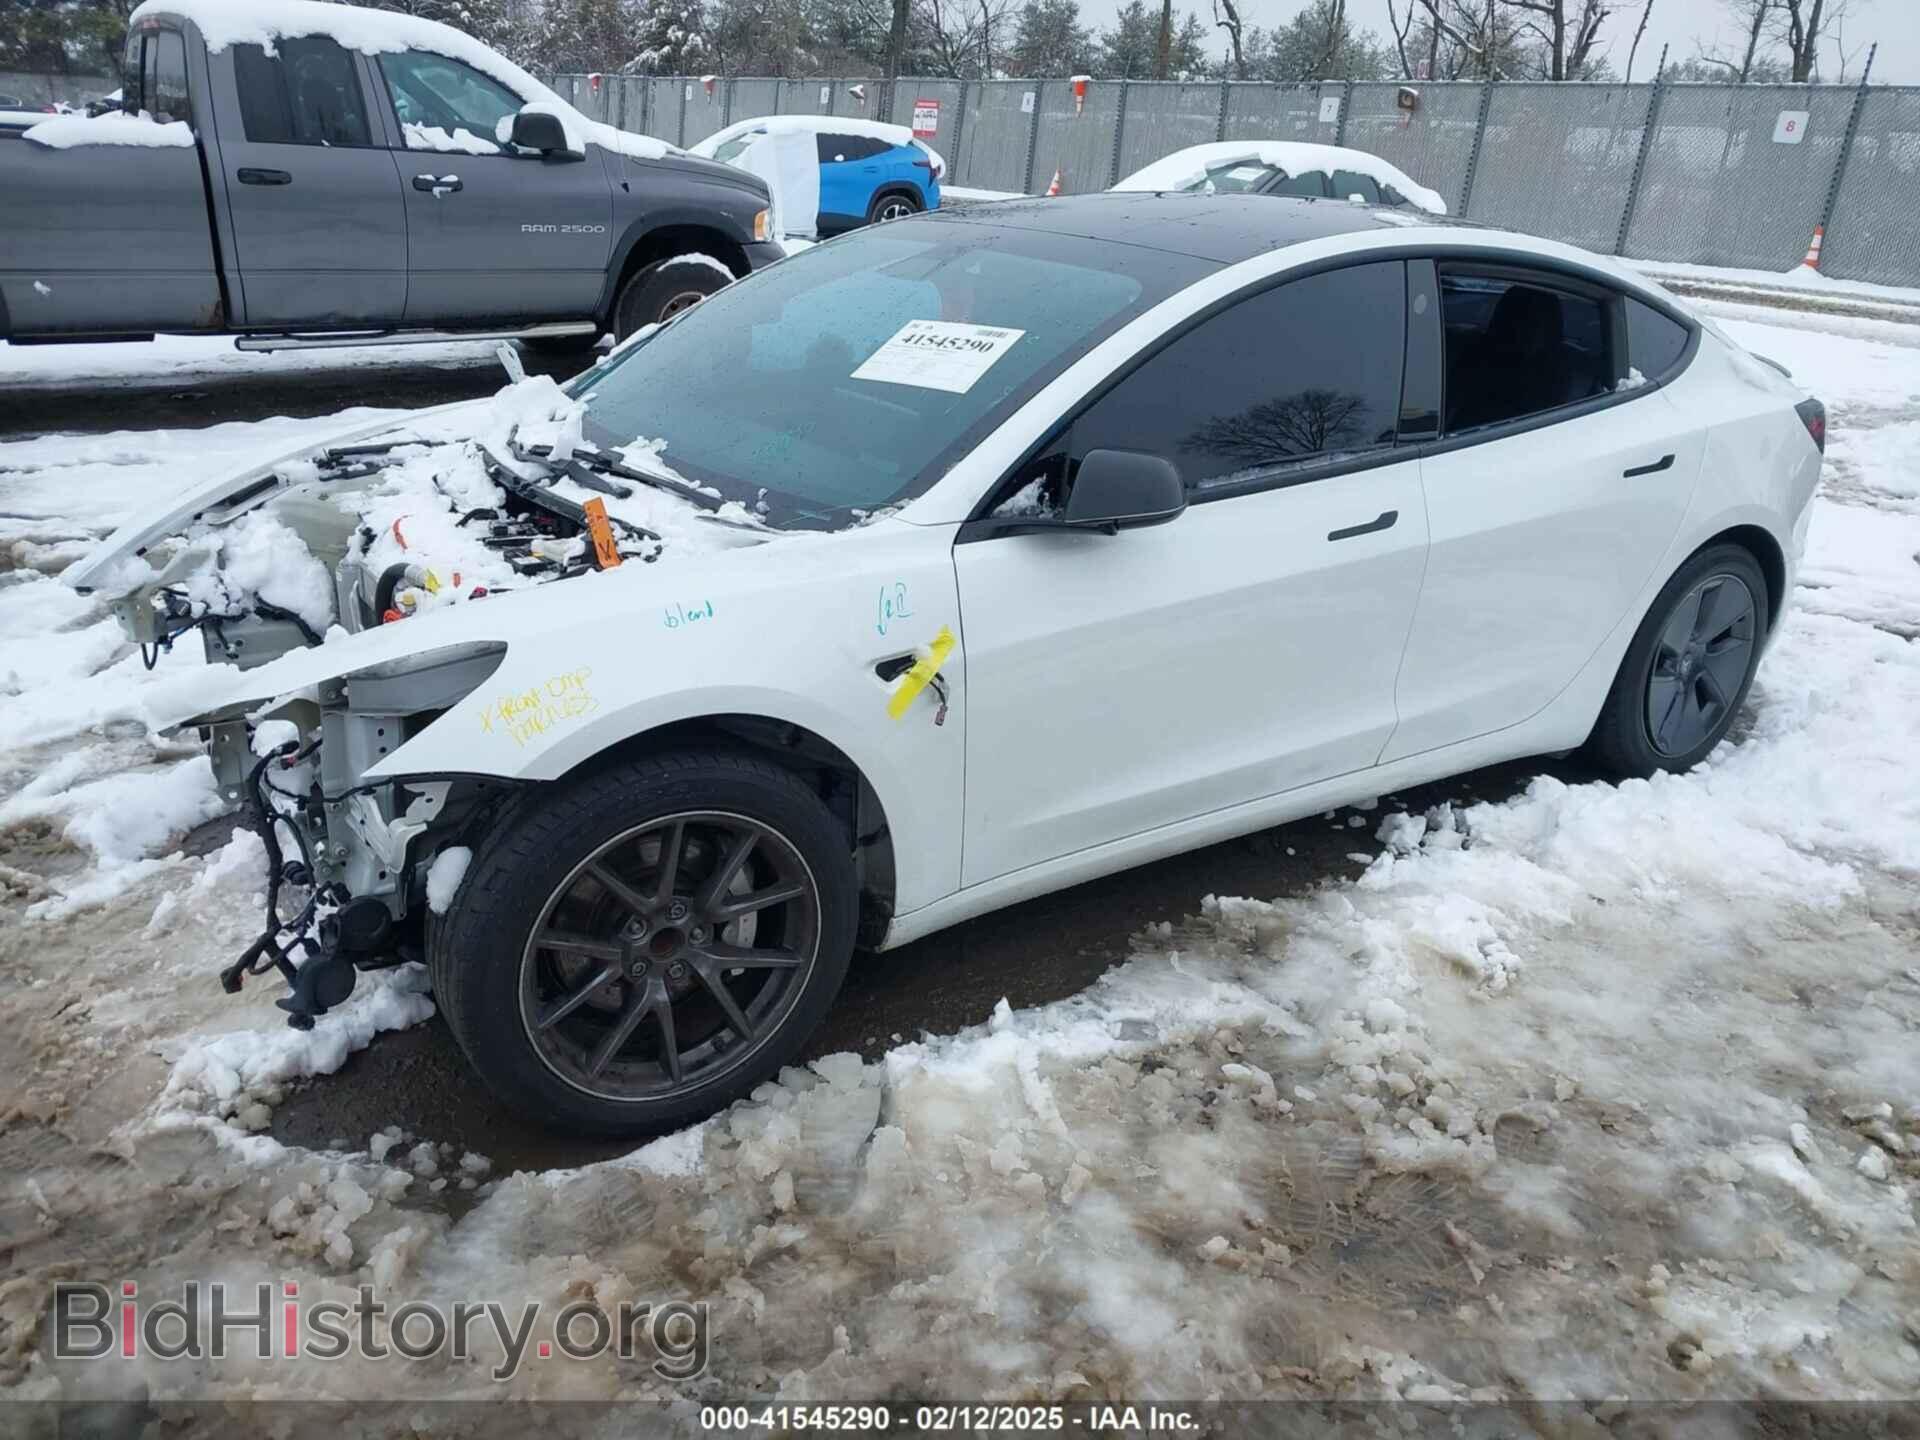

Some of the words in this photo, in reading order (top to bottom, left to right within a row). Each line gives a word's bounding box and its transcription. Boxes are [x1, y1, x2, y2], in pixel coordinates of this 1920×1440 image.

[1785, 120, 1797, 132] 8
[521, 224, 557, 233] RAM
[561, 224, 605, 233] 2500
[902, 334, 995, 353] 41545290
[664, 600, 714, 628] blend
